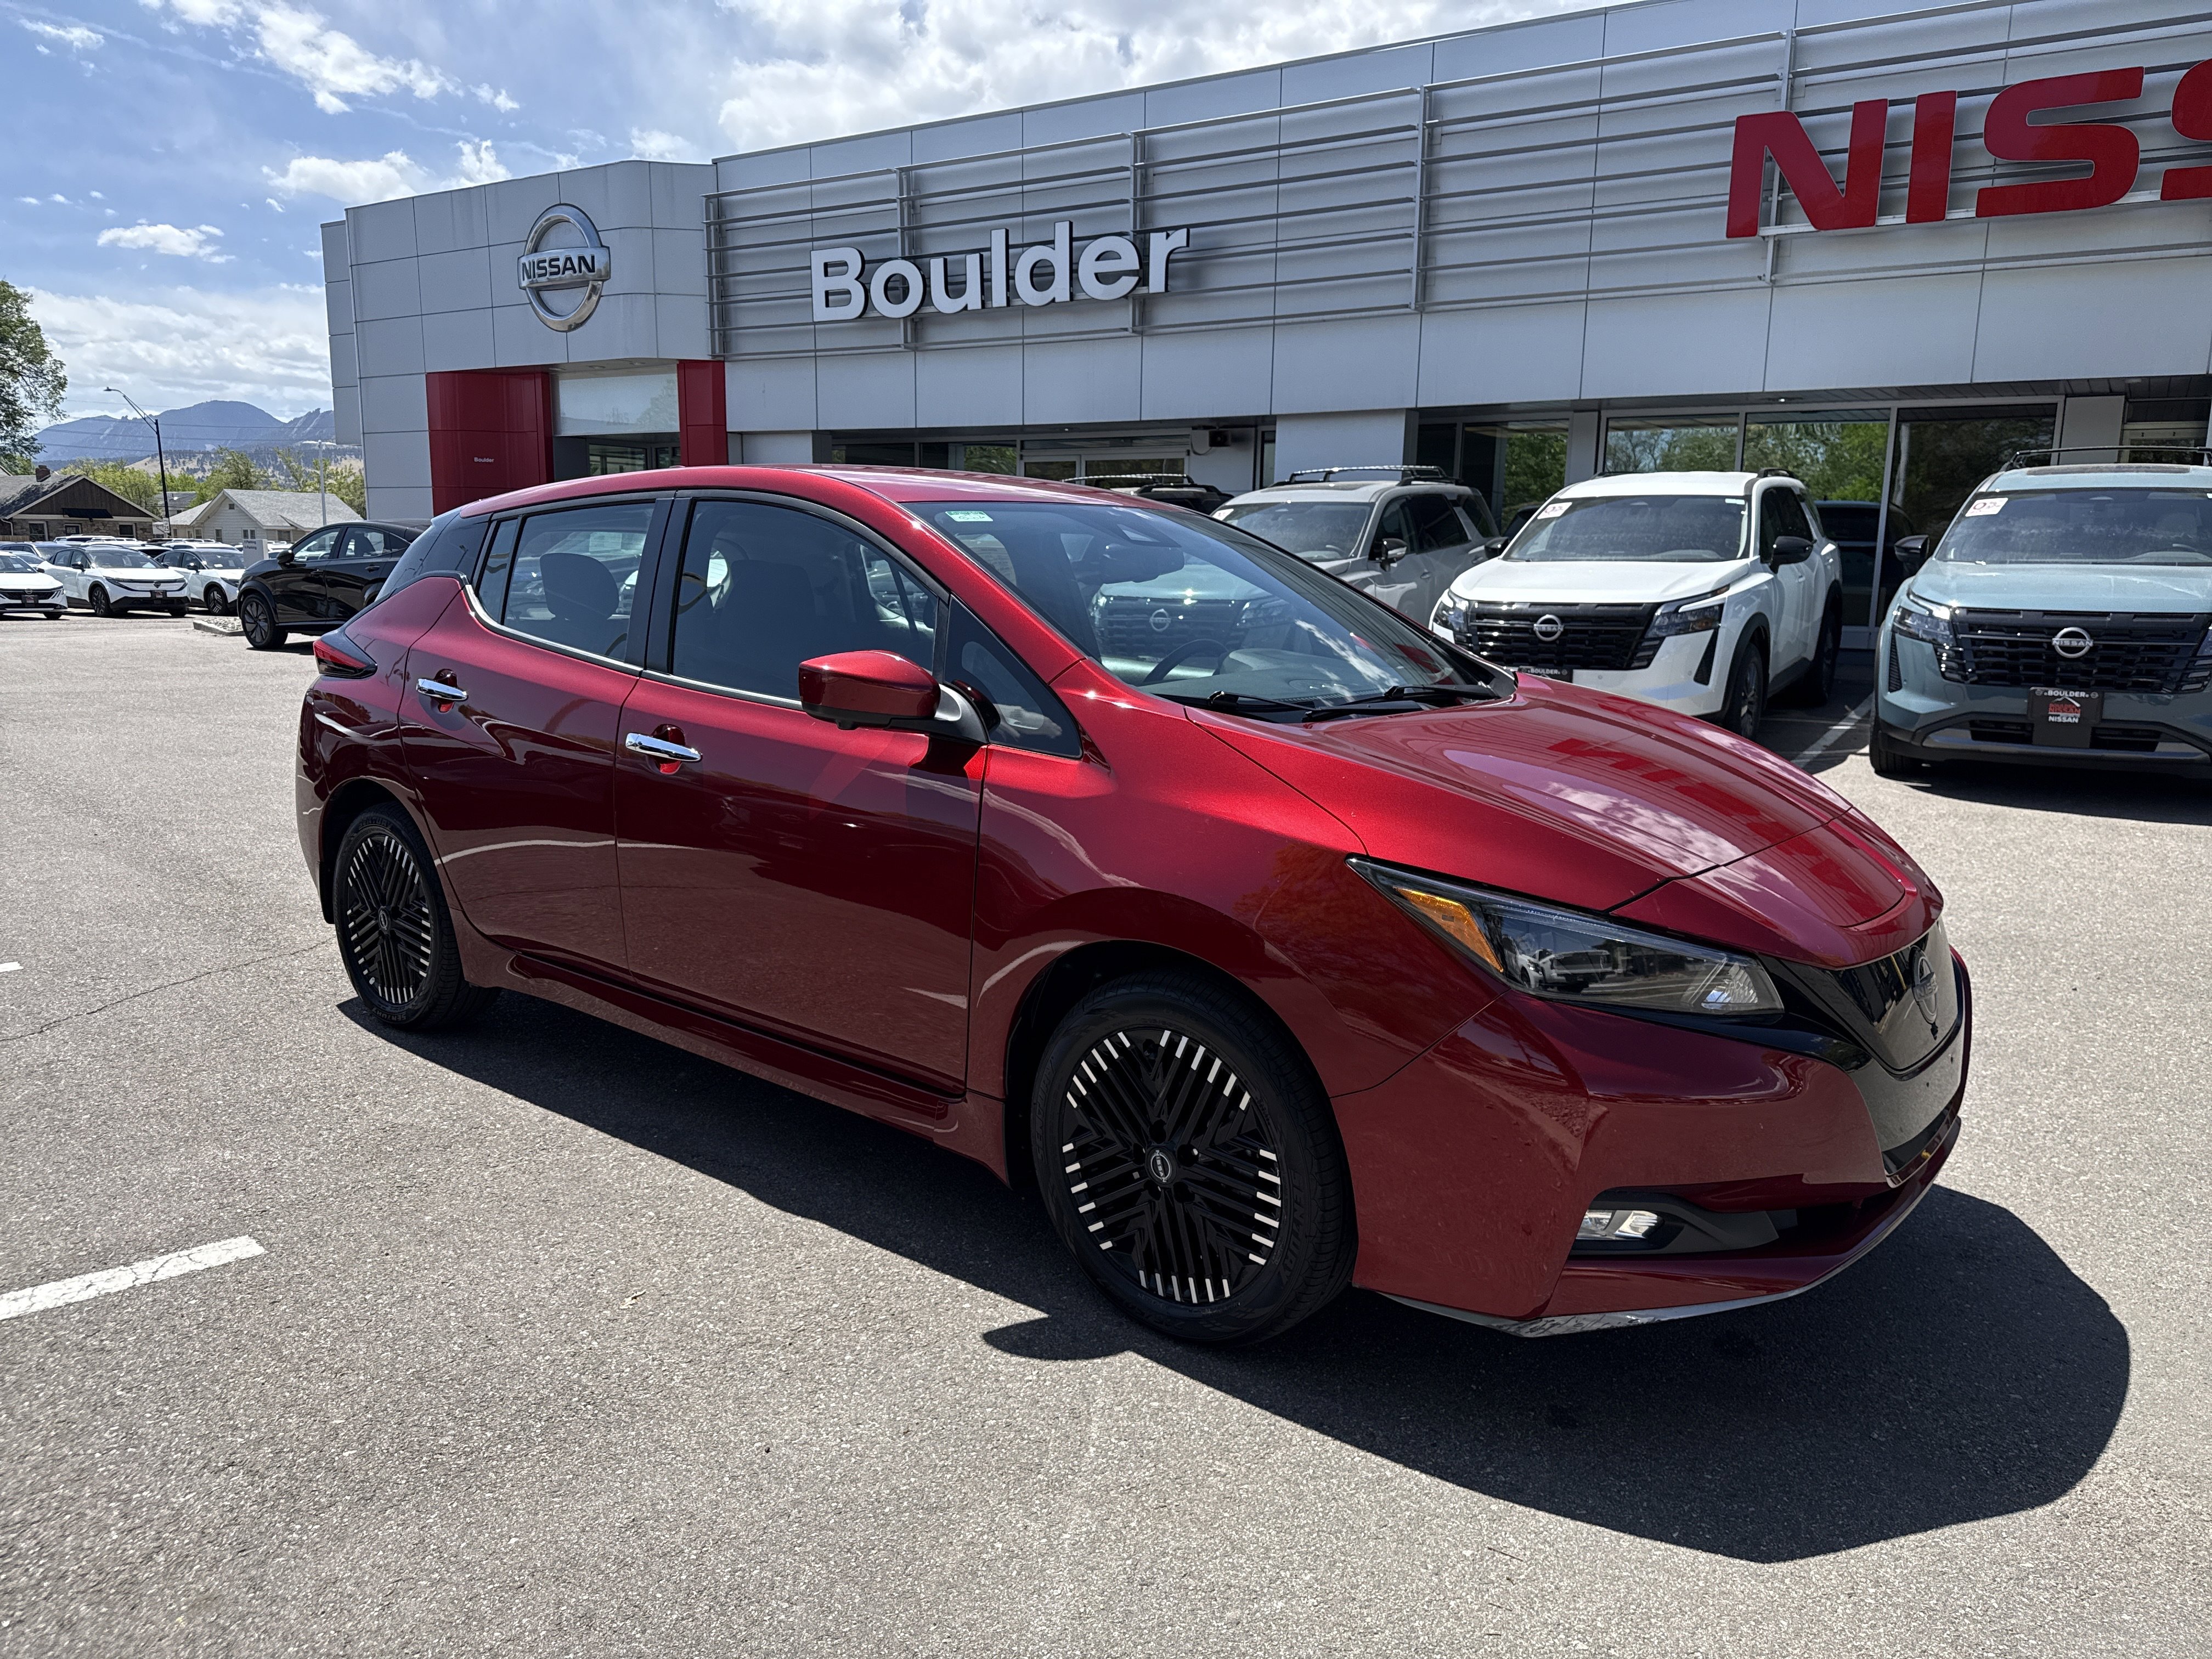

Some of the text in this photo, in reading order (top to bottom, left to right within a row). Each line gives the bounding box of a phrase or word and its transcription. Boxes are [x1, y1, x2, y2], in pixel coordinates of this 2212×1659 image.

[522, 254, 595, 281] NISSAN
[810, 220, 1189, 321] Boulder
[2048, 690, 2086, 698] BOULDER
[1155, 1150, 1167, 1182] NISSAN
